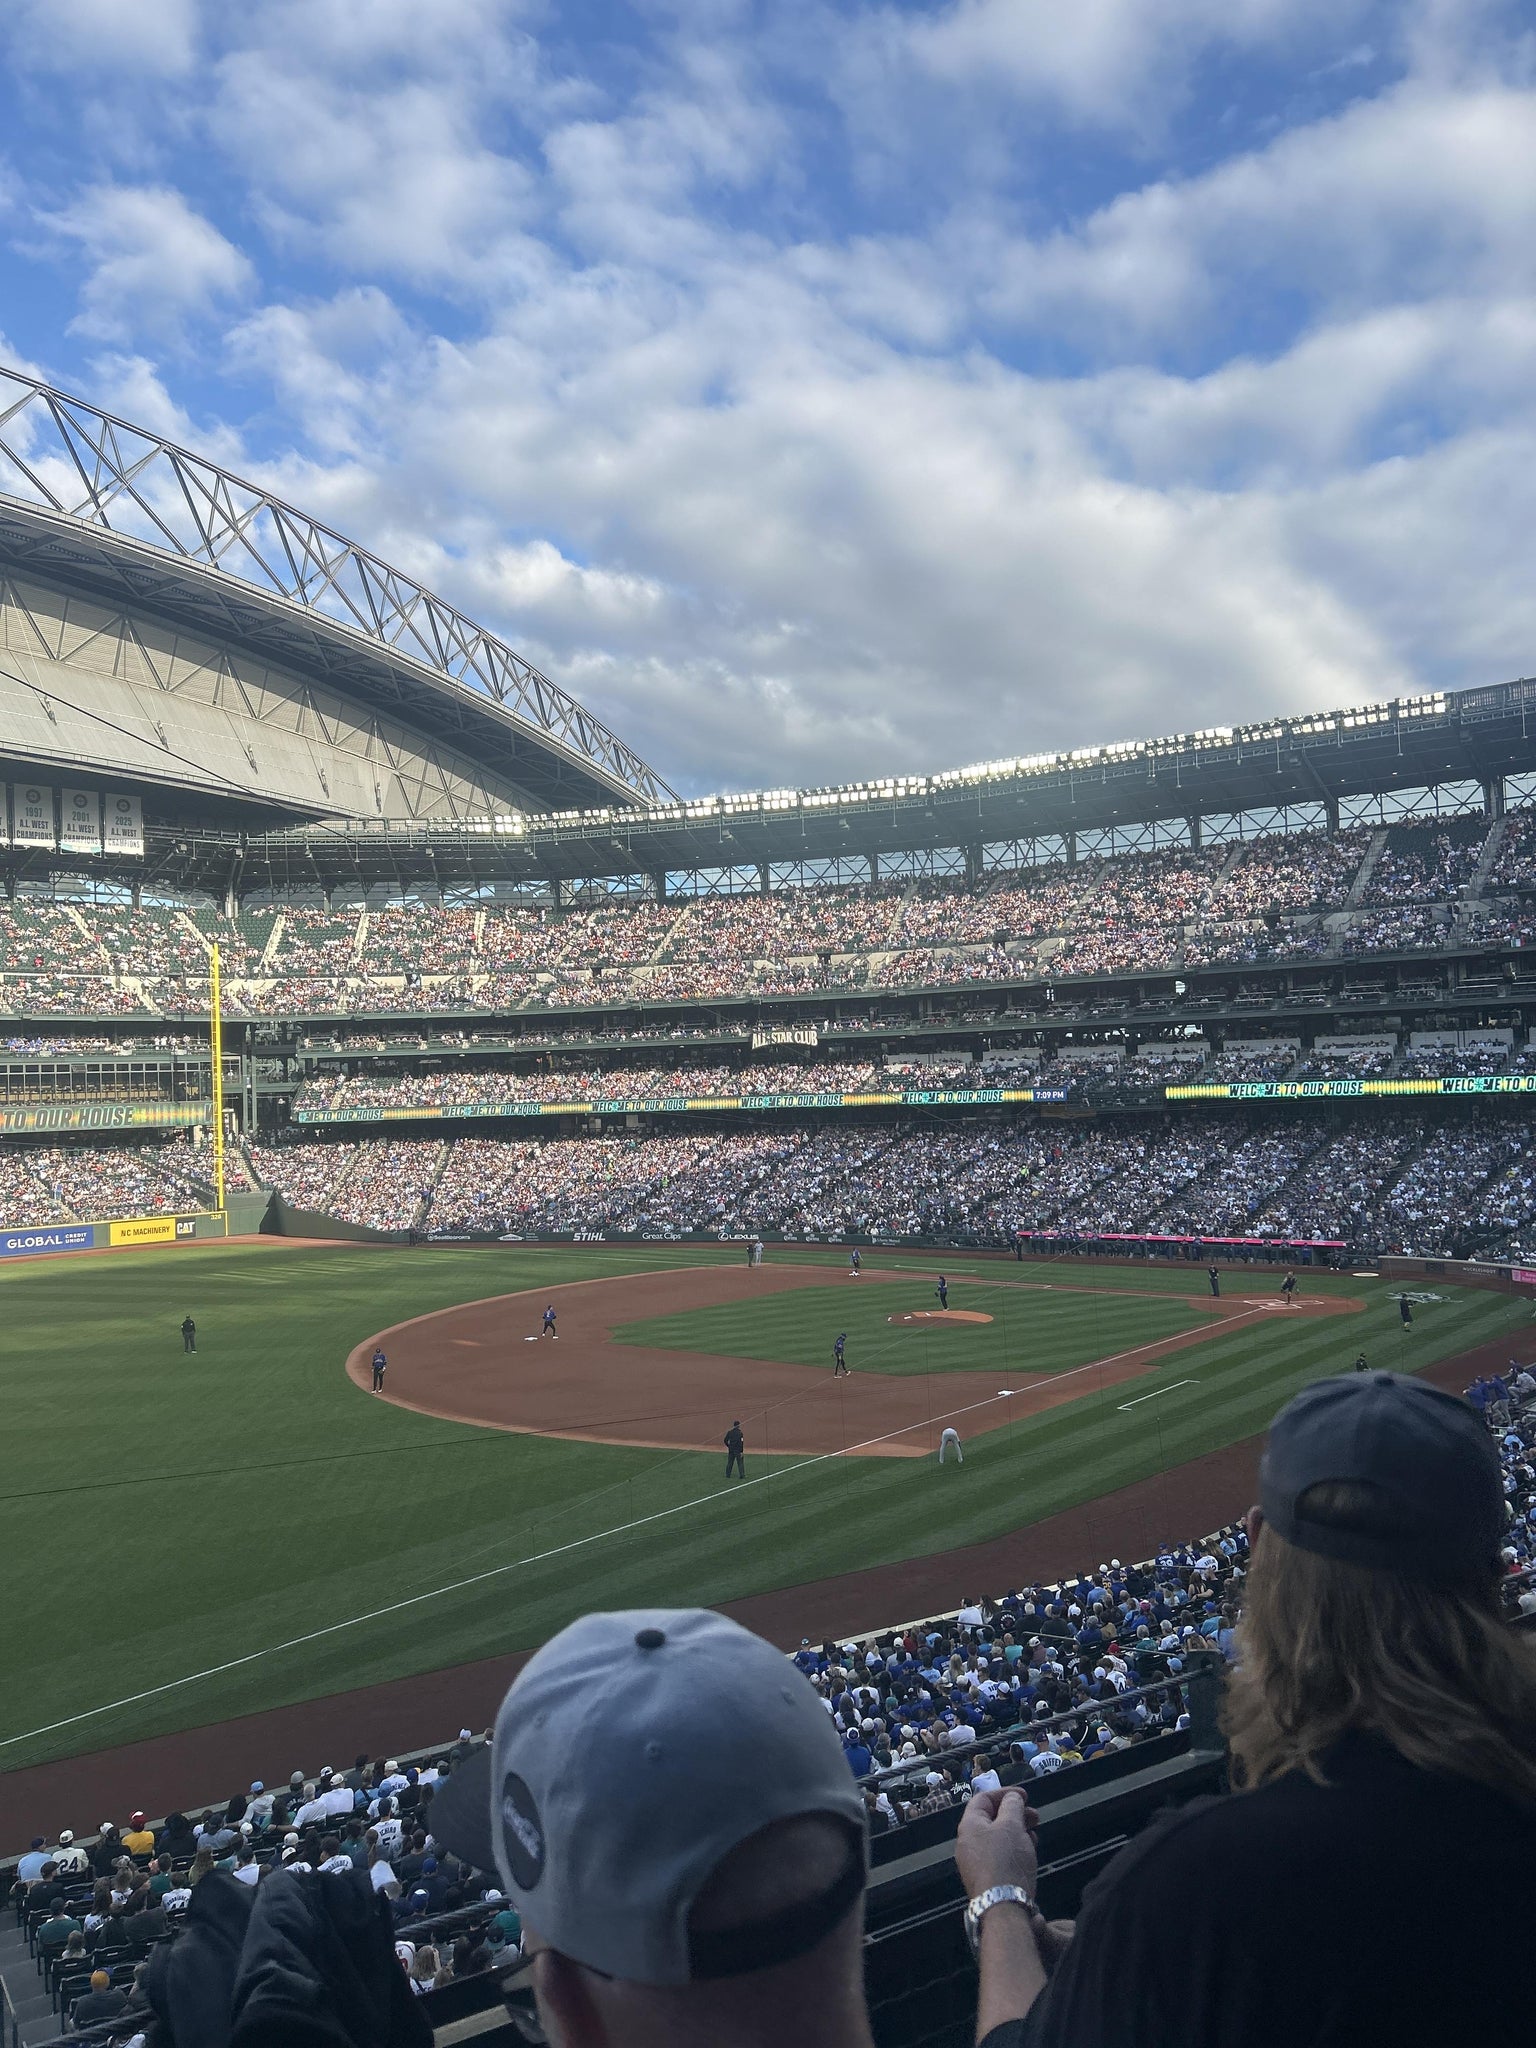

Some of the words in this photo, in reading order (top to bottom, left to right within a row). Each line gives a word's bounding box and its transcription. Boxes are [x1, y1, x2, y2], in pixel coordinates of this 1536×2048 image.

[25, 806, 43, 818] 1997
[72, 811, 90, 822] 2001
[20, 819, 31, 828] A.L.
[32, 820, 49, 830] WEST
[115, 816, 133, 827] 2025
[16, 829, 53, 840] CHAMPIONS
[66, 823, 78, 832] A.L.
[80, 825, 95, 834] WEST
[122, 828, 137, 838] WEST
[63, 834, 98, 845] CHAMPIONS
[107, 838, 140, 849] CHAMPIONS
[794, 1030, 818, 1046] CLUB
[1284, 1082, 1298, 1095] TO
[1302, 1082, 1325, 1095] OUR
[1328, 1081, 1364, 1095] HOUSE
[1505, 1077, 1521, 1091] TO
[783, 1096, 794, 1106] TO
[797, 1095, 815, 1106] OUR
[816, 1094, 844, 1105] HOUSE
[943, 1092, 953, 1103] TO
[957, 1091, 974, 1103] OUR
[976, 1090, 1003, 1102] HOUSE
[1036, 1091, 1051, 1100] 7:09
[1052, 1090, 1064, 1099] PM
[486, 1105, 496, 1116] TO
[500, 1105, 517, 1115] OUR
[518, 1103, 542, 1114] HOUSE
[632, 1101, 641, 1111] TO
[644, 1100, 660, 1111] OUR
[663, 1099, 688, 1110] HOUSE
[3, 1109, 27, 1130] TO
[35, 1107, 73, 1129] OUR
[78, 1106, 134, 1127] HOUSE
[322, 1111, 333, 1121] TO
[336, 1110, 356, 1121] OUR
[357, 1108, 385, 1120] HOUSE
[133, 1225, 170, 1236] MACHINERY
[176, 1221, 195, 1234] CAT
[7, 1235, 63, 1249] GLOBAL
[573, 1232, 606, 1241] STIHL
[642, 1232, 663, 1240] Great
[663, 1232, 681, 1241] Clips
[59, 1856, 79, 1874] 24
